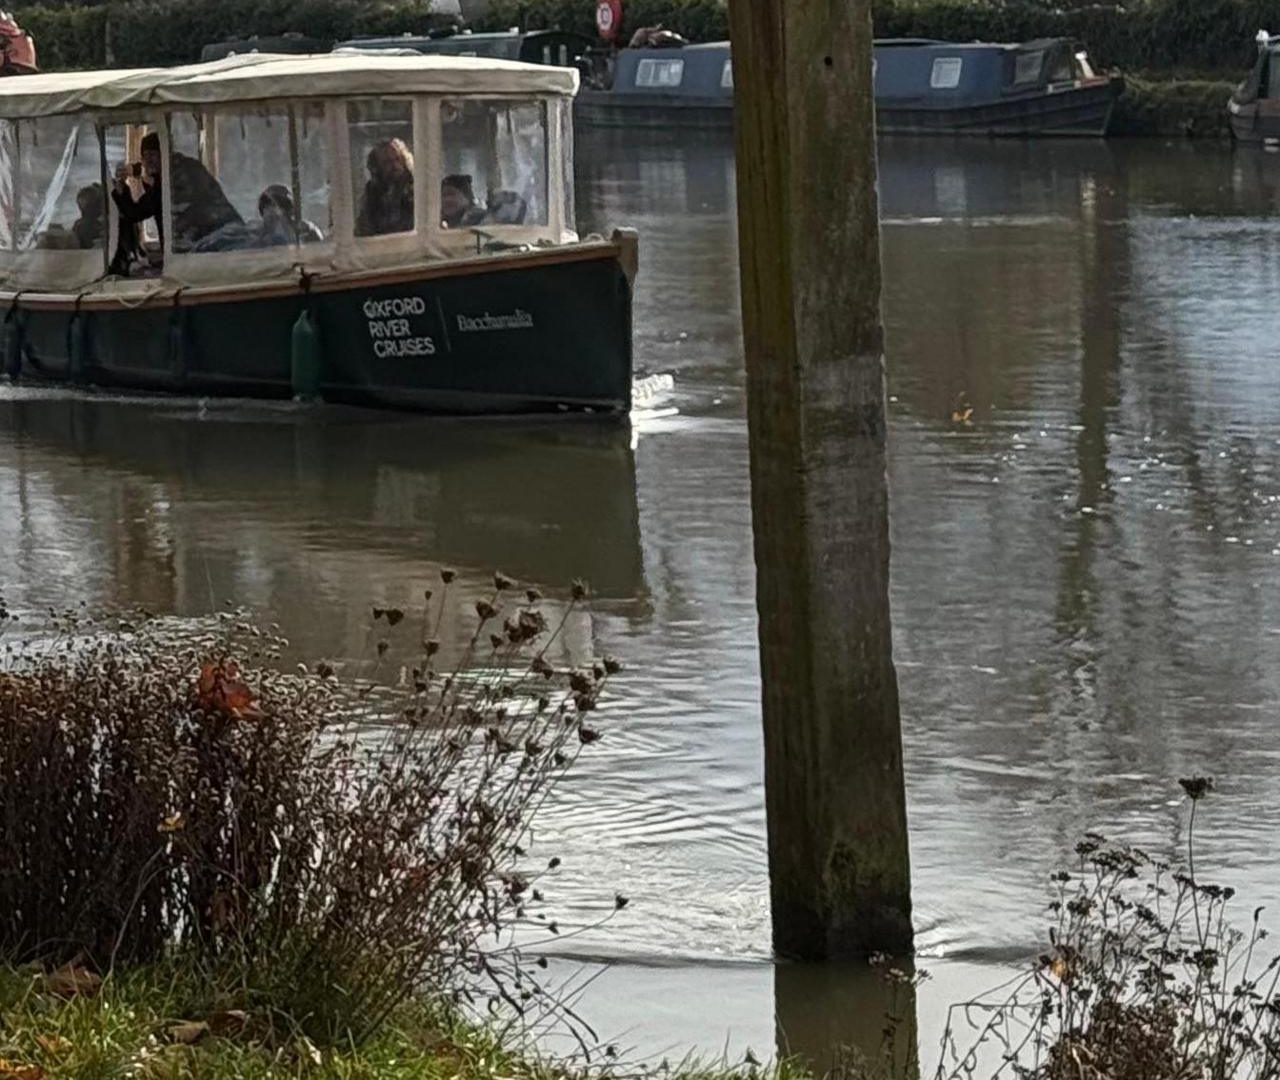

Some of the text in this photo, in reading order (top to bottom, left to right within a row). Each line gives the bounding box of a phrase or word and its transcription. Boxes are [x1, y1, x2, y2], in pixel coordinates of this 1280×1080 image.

[363, 297, 425, 318] OXFORD
[369, 319, 411, 338] RIVER
[374, 337, 435, 358] CRUISES
